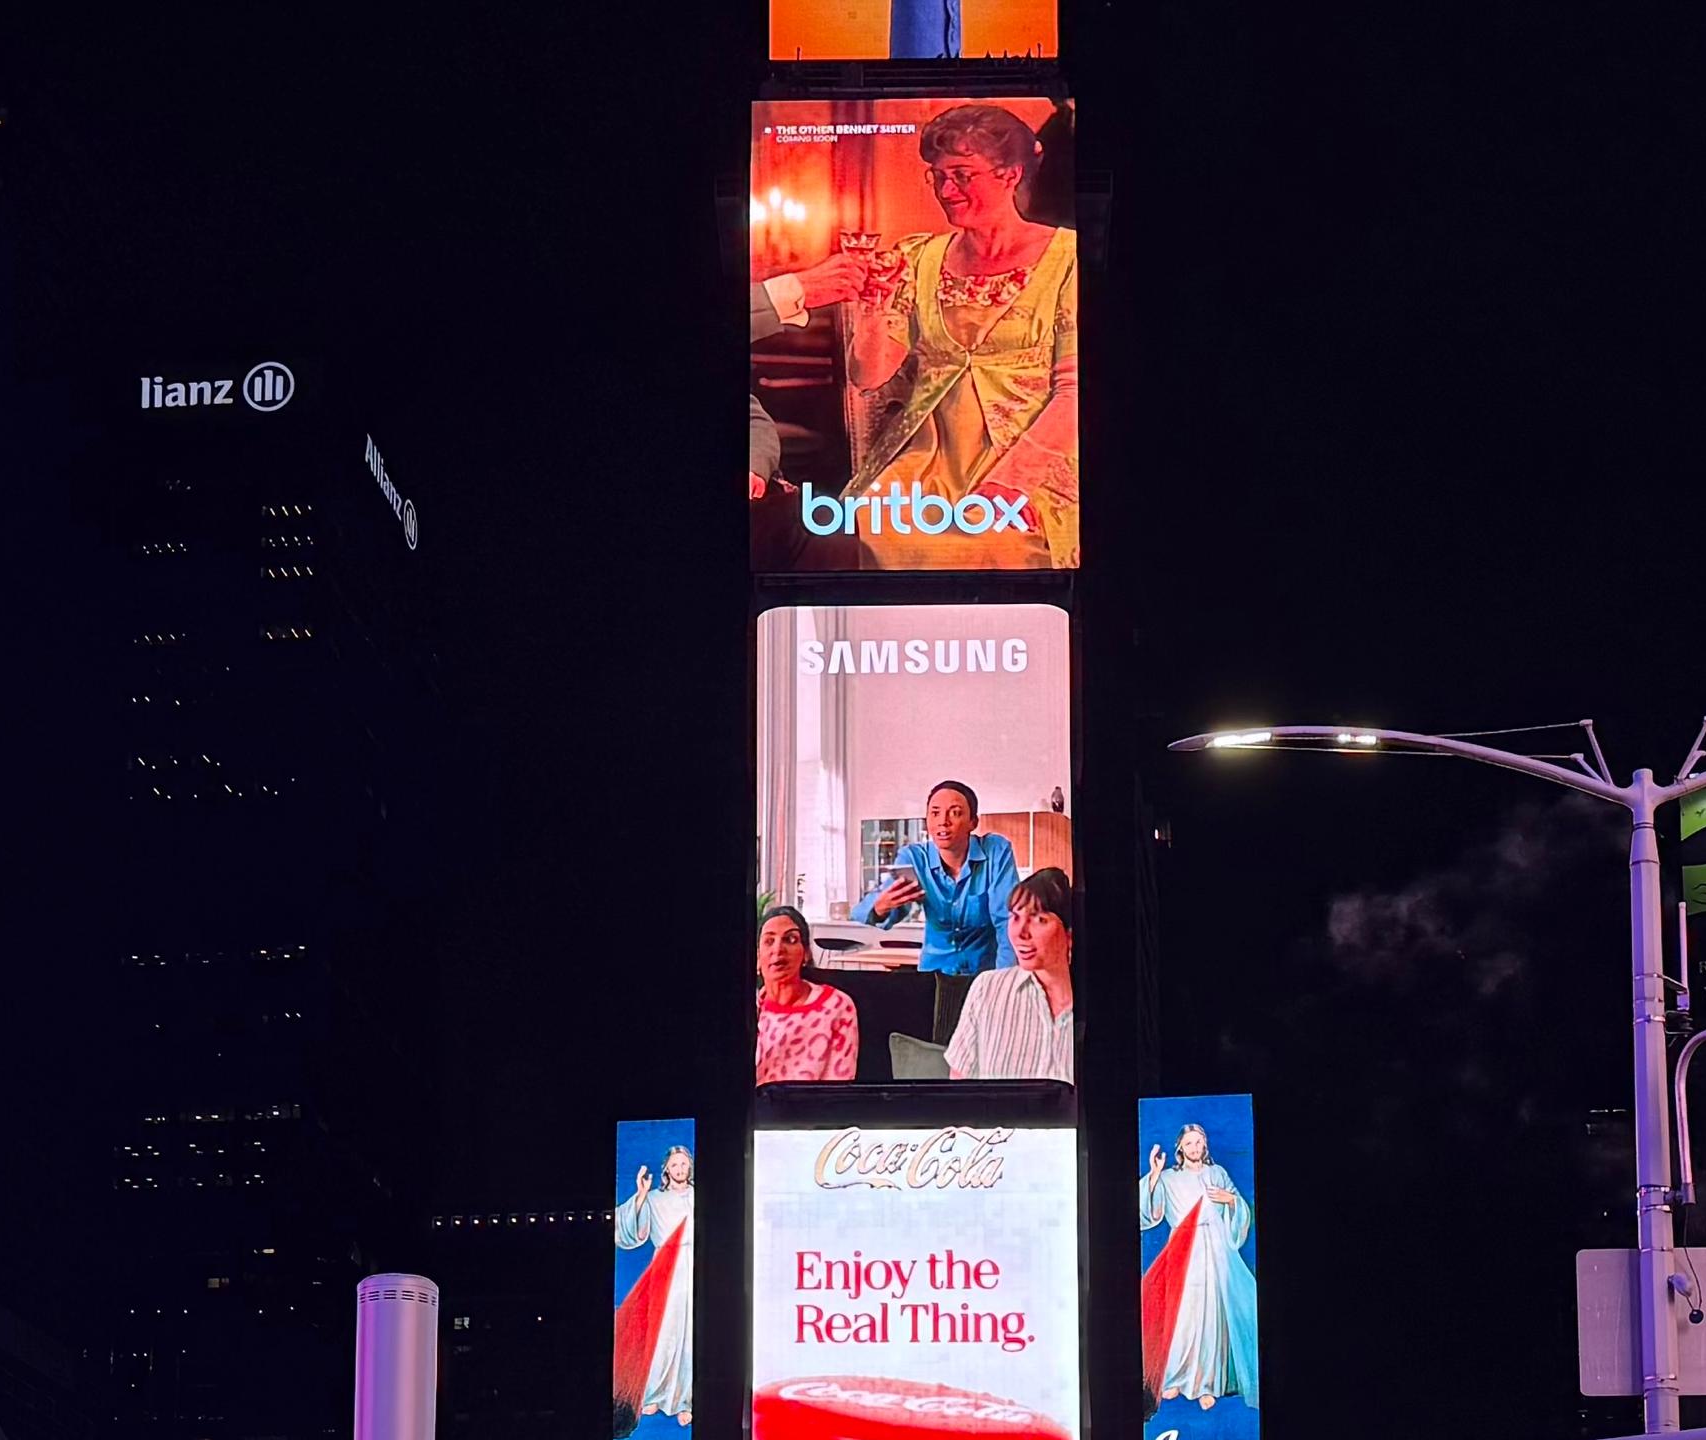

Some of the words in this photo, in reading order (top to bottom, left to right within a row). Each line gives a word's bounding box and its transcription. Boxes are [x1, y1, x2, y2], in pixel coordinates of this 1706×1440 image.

[140, 376, 234, 409] lianz
[364, 432, 403, 522] Allianz
[802, 481, 1030, 536] britbox
[800, 637, 1029, 676] SAMSUNG
[795, 1250, 918, 1300] Enjoy
[927, 1249, 1000, 1291] the
[795, 1302, 889, 1344] Real
[899, 1302, 1035, 1352] Thing.
